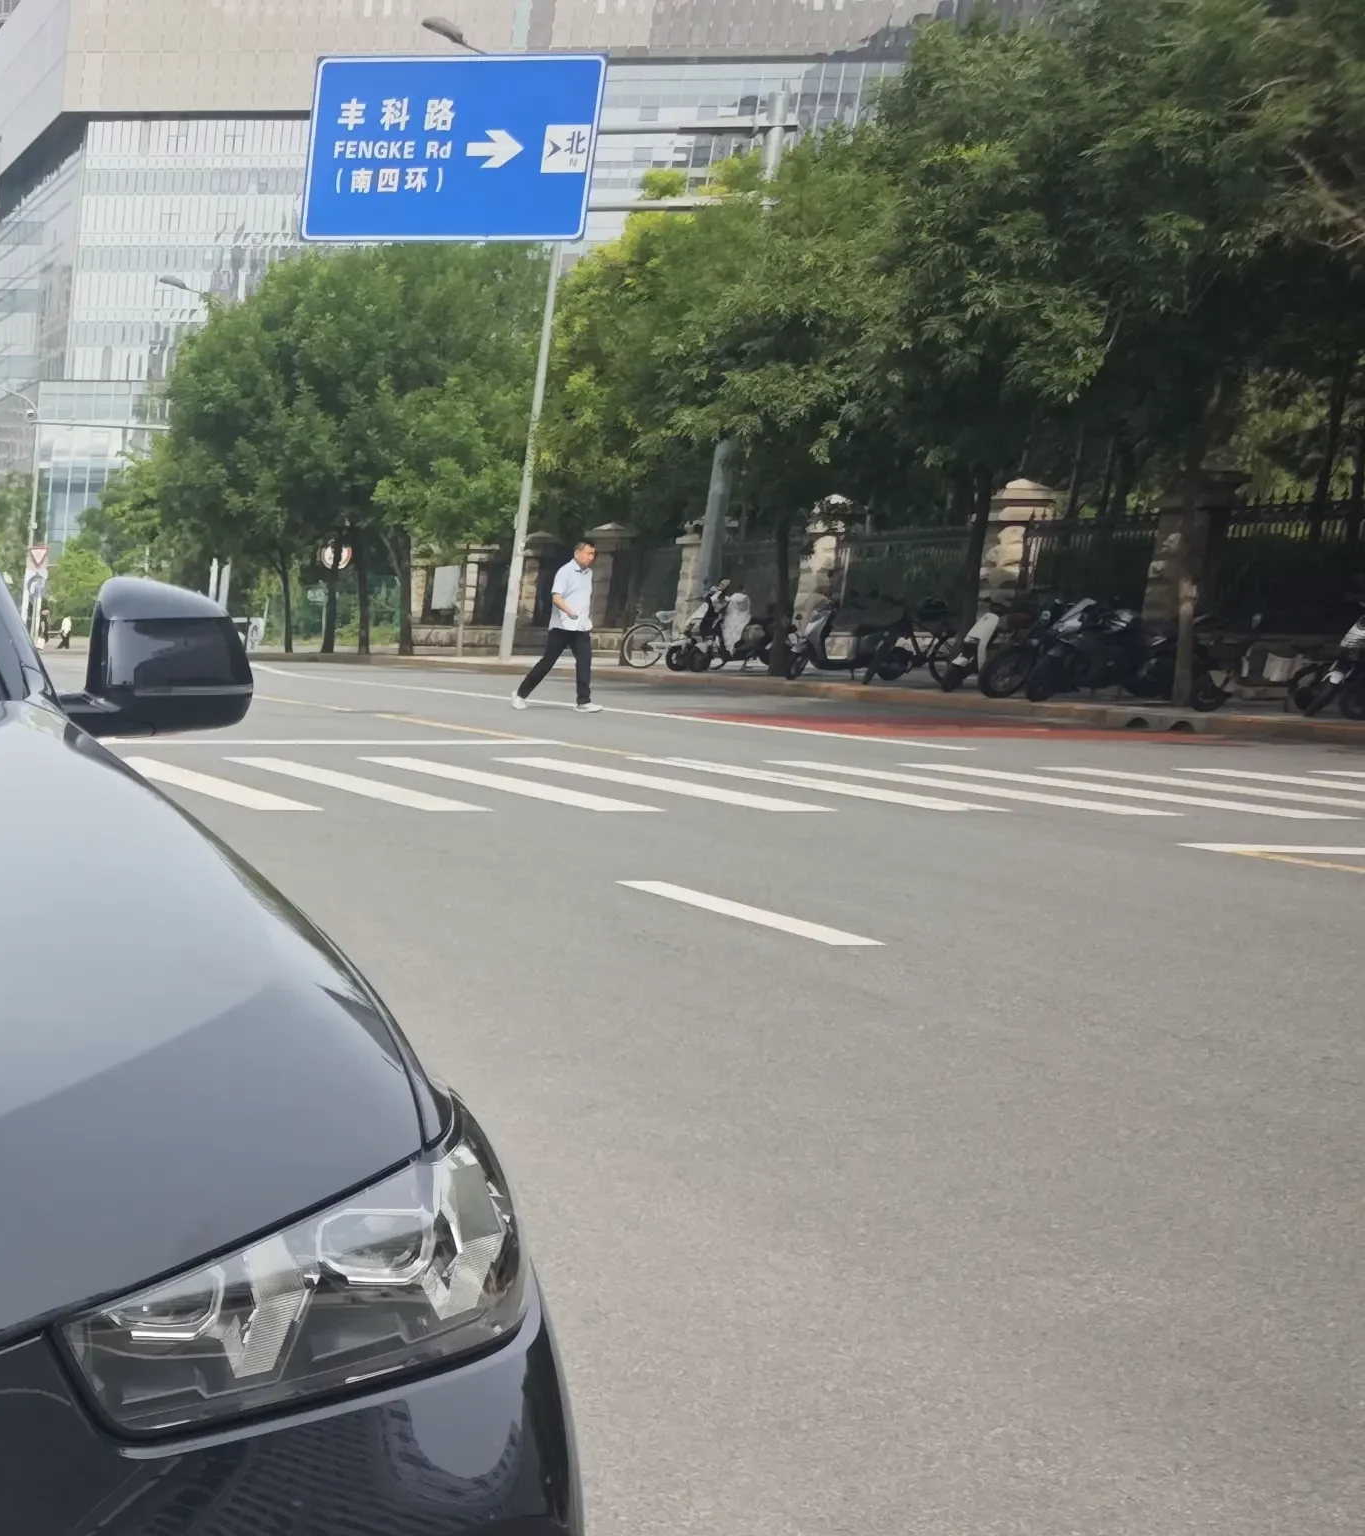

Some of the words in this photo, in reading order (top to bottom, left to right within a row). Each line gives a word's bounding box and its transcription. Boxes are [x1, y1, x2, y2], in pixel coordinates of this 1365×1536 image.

[337, 97, 456, 131] 丰科路
[333, 140, 416, 159] FENGKE
[425, 140, 452, 159] Rd
[564, 130, 586, 155] 北
